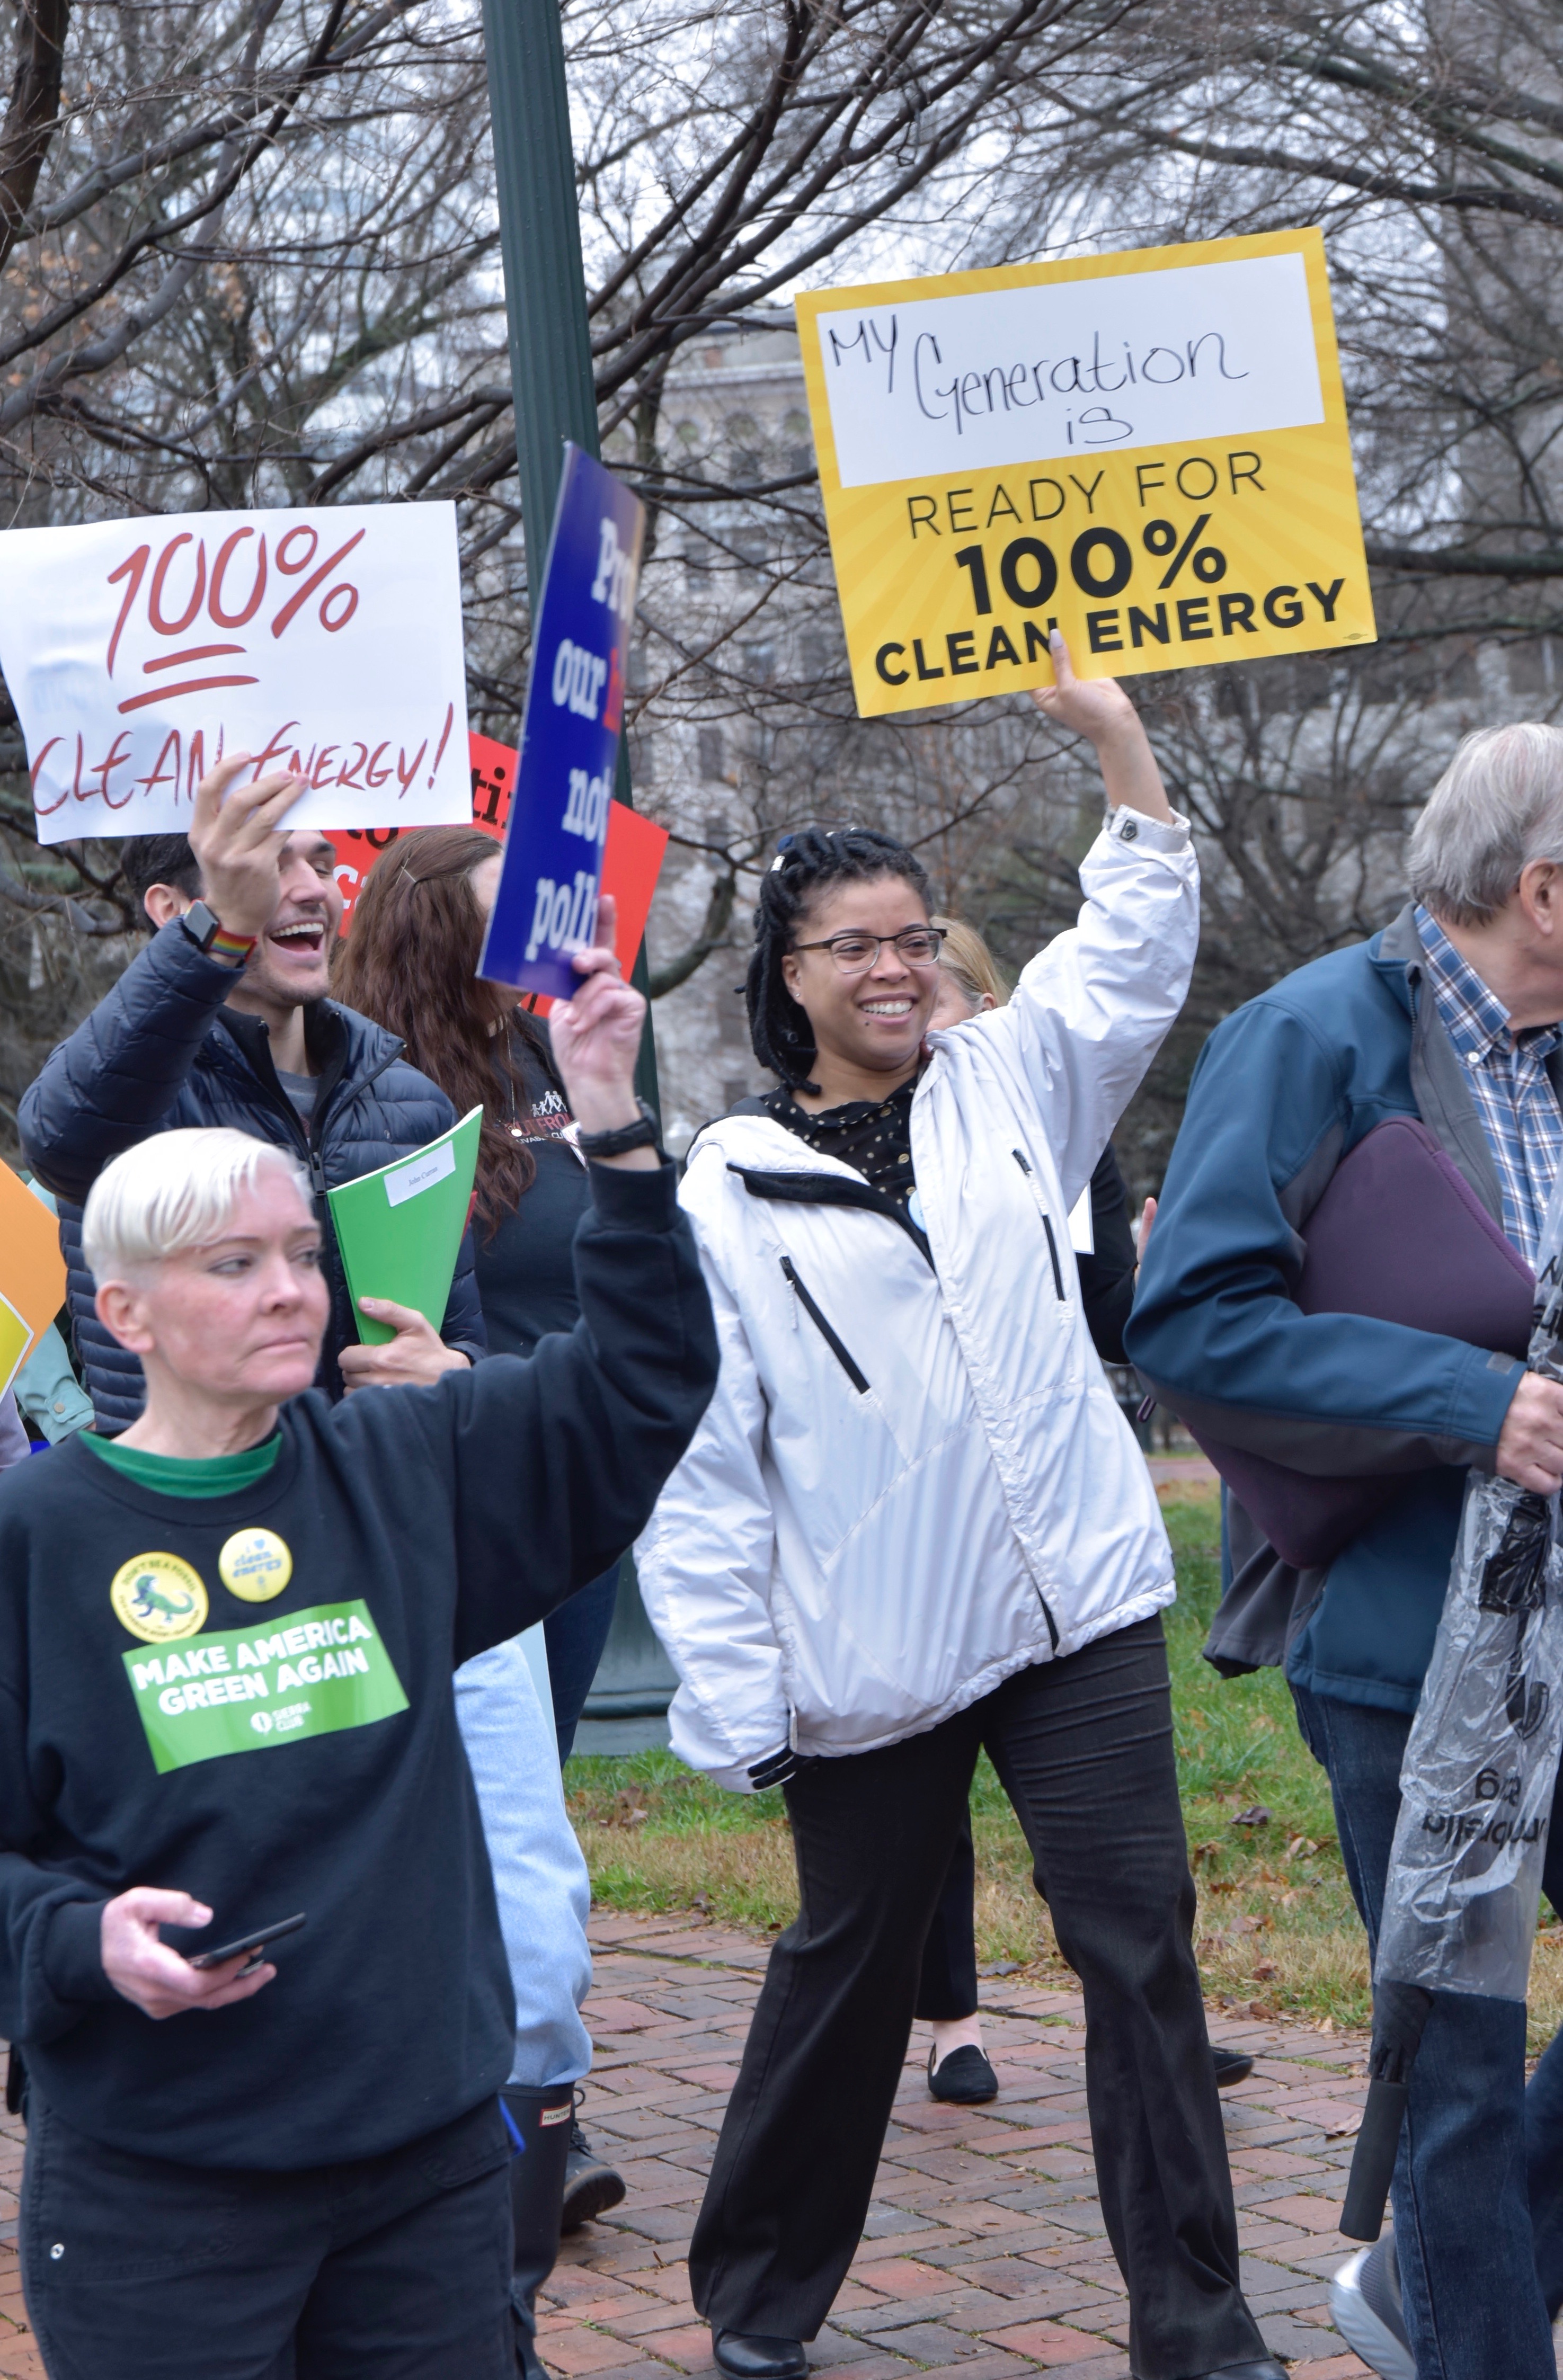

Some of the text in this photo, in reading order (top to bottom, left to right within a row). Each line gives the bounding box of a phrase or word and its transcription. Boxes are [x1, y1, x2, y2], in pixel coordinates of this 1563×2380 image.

[828, 314, 1250, 435] MY Generation
[1067, 407, 1133, 444] is
[908, 451, 1266, 539] READY FOR
[108, 524, 366, 680] 100%
[955, 513, 1227, 616] 100%
[875, 578, 1346, 686] CLEAN ENERGY
[552, 638, 607, 720] our
[524, 870, 599, 962] poll
[408, 1176, 421, 1186] John
[132, 1646, 231, 1691] MAKE
[237, 1615, 372, 1669] AMERICA
[158, 1647, 370, 1716] GREEN AGAIN
